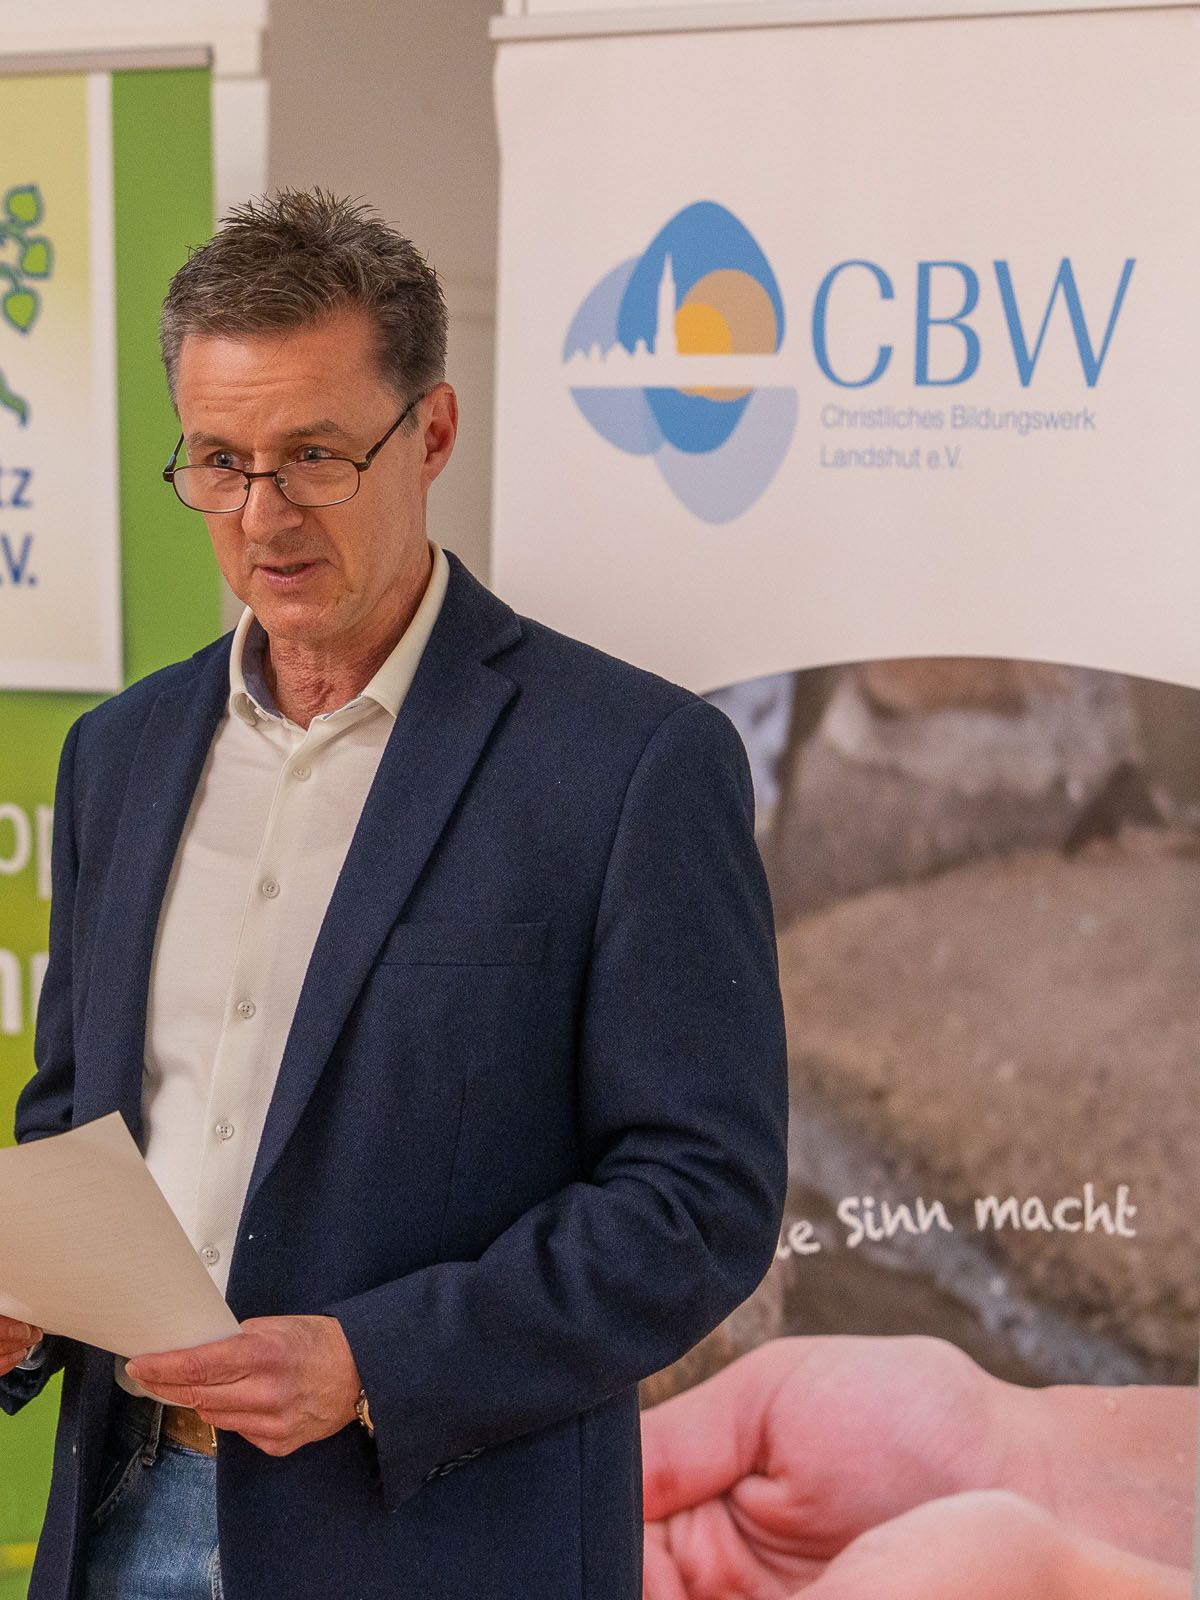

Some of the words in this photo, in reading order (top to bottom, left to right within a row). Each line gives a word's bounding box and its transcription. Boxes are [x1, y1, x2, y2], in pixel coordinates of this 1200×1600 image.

[811, 257, 1137, 388] CBW
[821, 404, 945, 430] Christliches
[950, 404, 1097, 435] Bildungswerk
[819, 445, 922, 469] Landshut
[926, 446, 963, 470] e.V.
[975, 1183, 1137, 1237] macht
